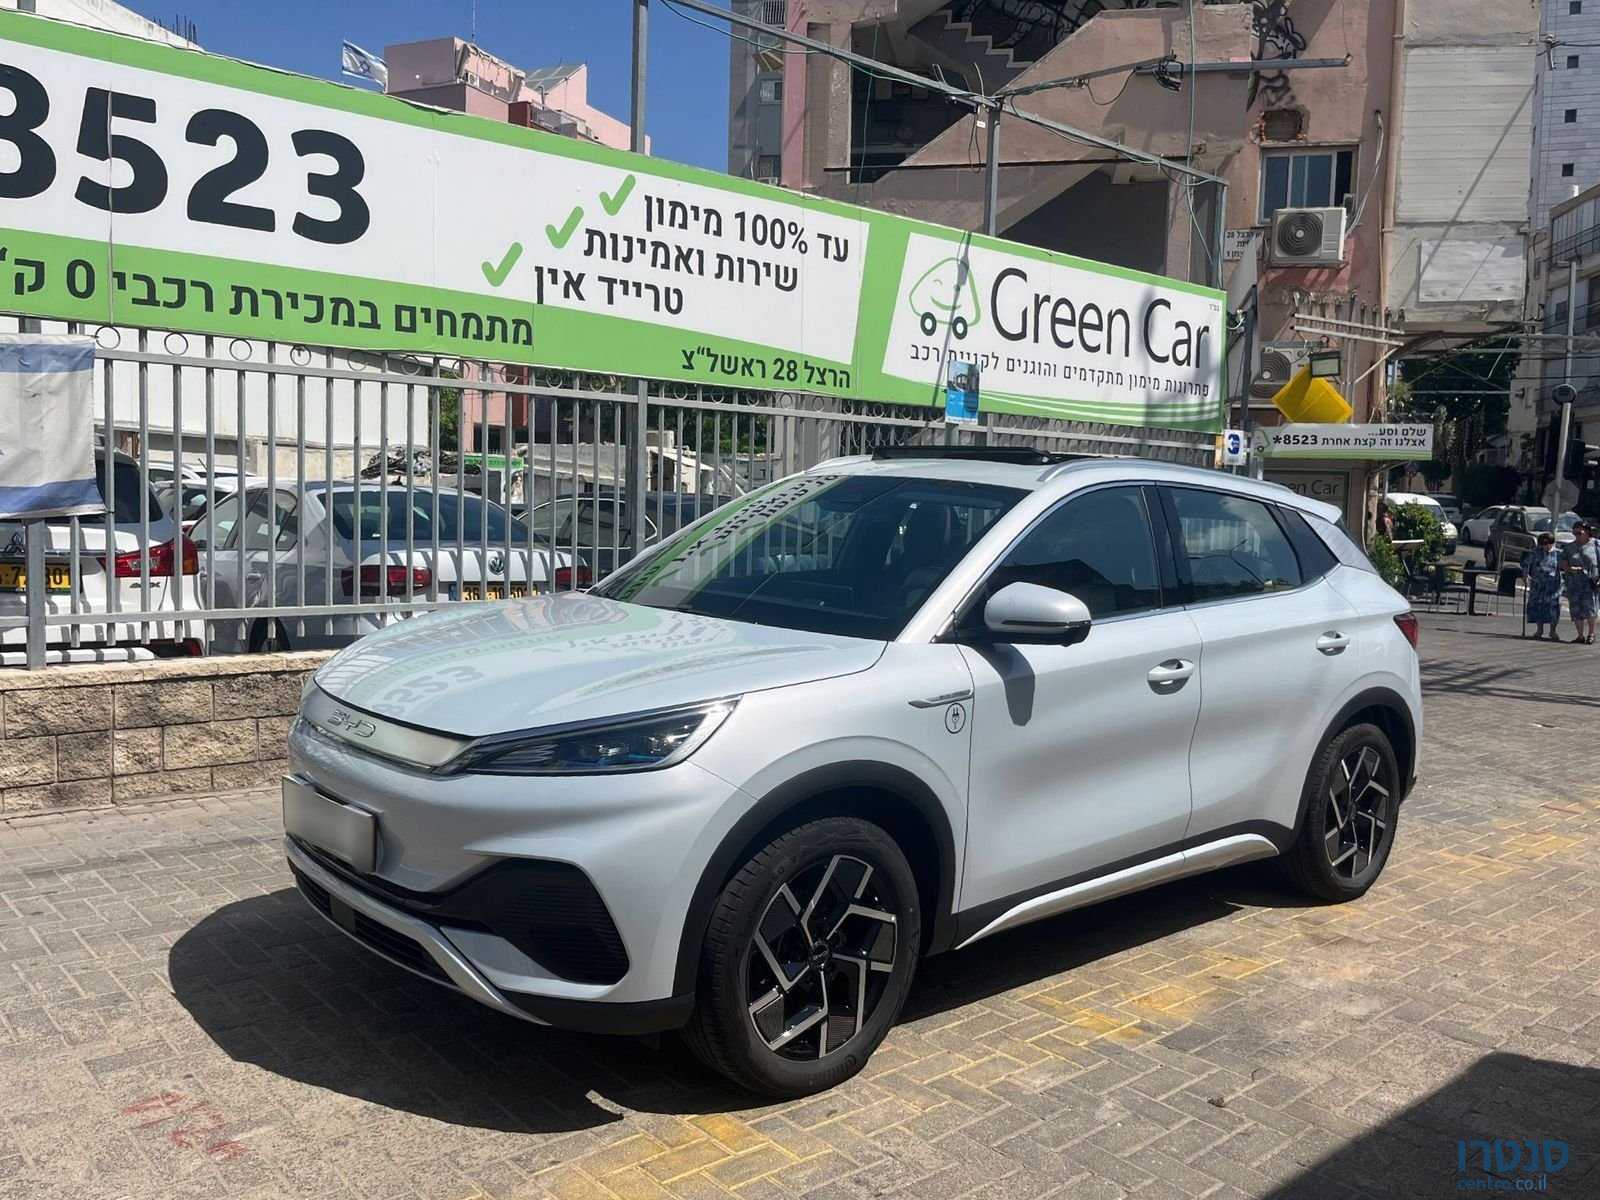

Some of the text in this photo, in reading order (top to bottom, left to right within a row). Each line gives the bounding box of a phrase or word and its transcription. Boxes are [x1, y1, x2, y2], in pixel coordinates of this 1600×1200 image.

[642, 194, 848, 261] עד 100% מימון
[584, 229, 797, 291] שירות ואמינות
[67, 260, 95, 298] 0
[113, 272, 213, 312] רכבי
[535, 267, 682, 314] טרייד אין
[230, 285, 380, 329] במכירת
[991, 268, 1209, 368] Green Car
[395, 305, 532, 345] מתמחים
[911, 345, 939, 361] רכב
[774, 358, 797, 381] 28
[804, 361, 849, 388] הרצל
[1007, 358, 1056, 376] והוגנים
[1064, 366, 1122, 387] מתקדמים
[1129, 373, 1160, 391] מימון
[1165, 379, 1209, 397] פתרונות
[1321, 437, 1350, 446] אחרת
[1354, 437, 1376, 448] קצת
[1379, 438, 1392, 446] זה
[1395, 436, 1426, 447] אצלנו
[1401, 426, 1427, 437] שלם
[1311, 479, 1340, 495] Car
[327, 708, 376, 738] BYD
